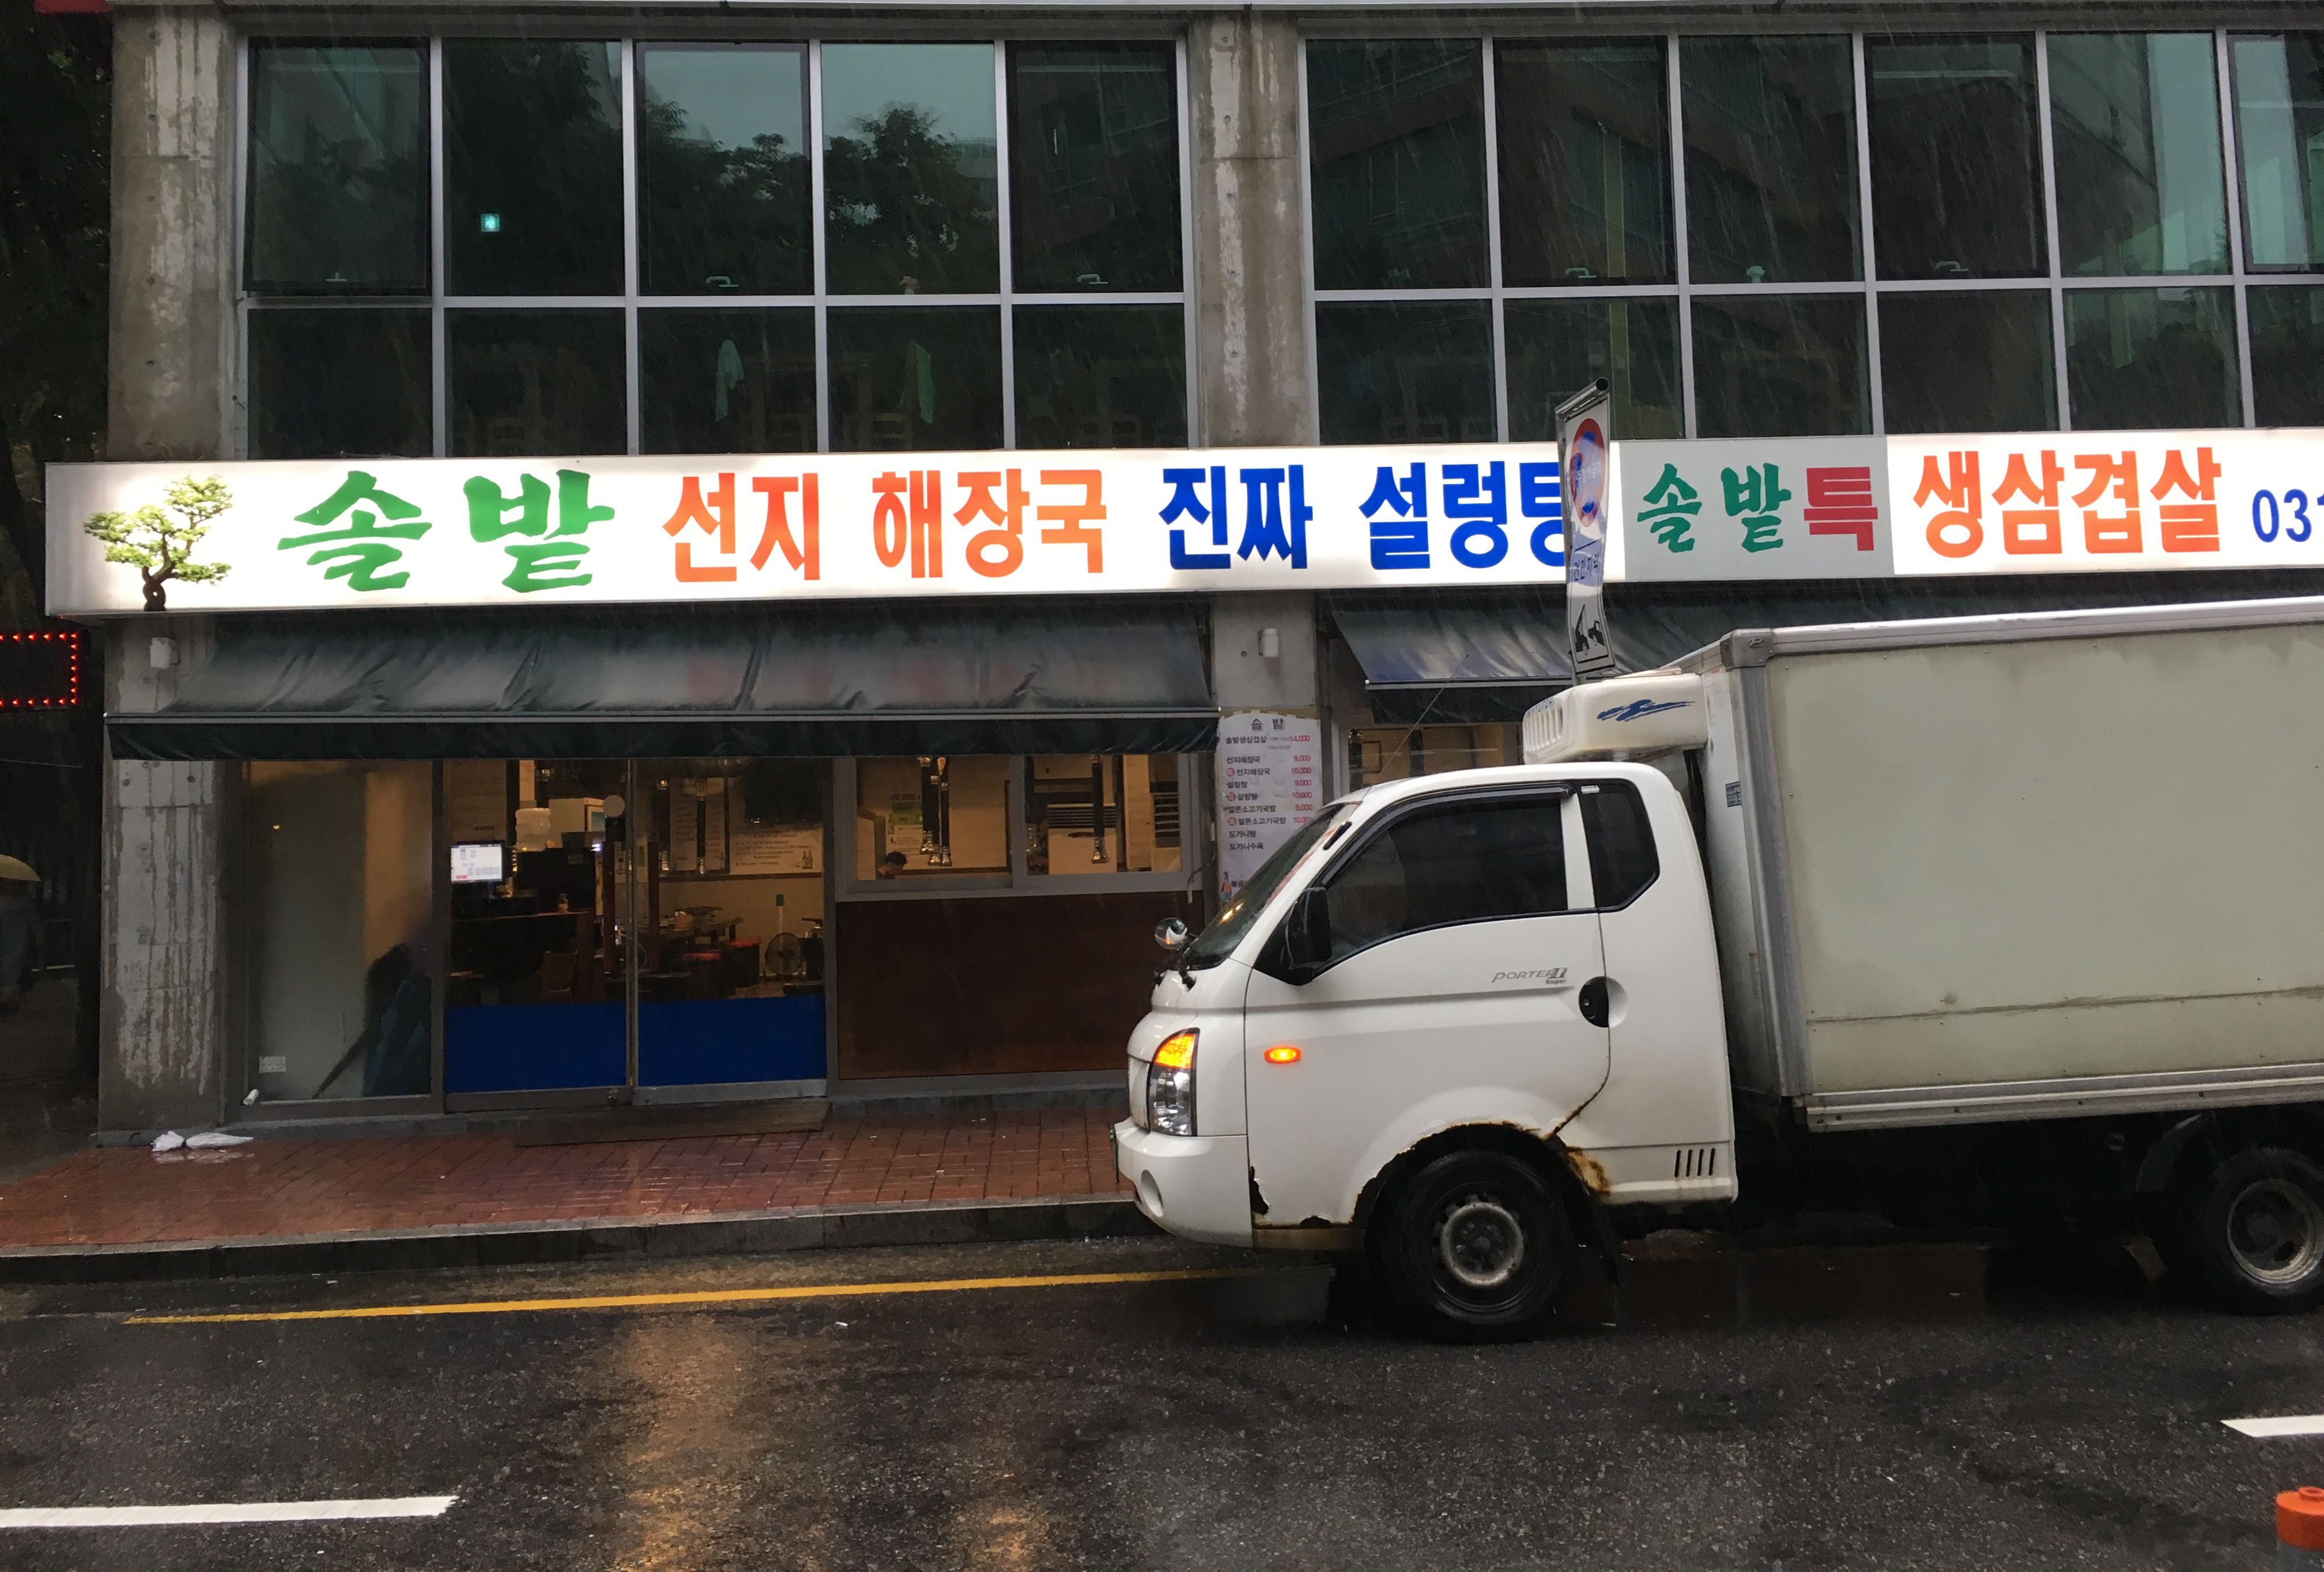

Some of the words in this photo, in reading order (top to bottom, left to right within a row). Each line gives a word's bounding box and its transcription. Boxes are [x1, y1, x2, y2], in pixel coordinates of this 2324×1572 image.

[662, 473, 820, 582] 선지
[872, 468, 1107, 578] 해장국
[1158, 465, 1313, 570] 진짜
[1913, 447, 2222, 558] 생삼겹살
